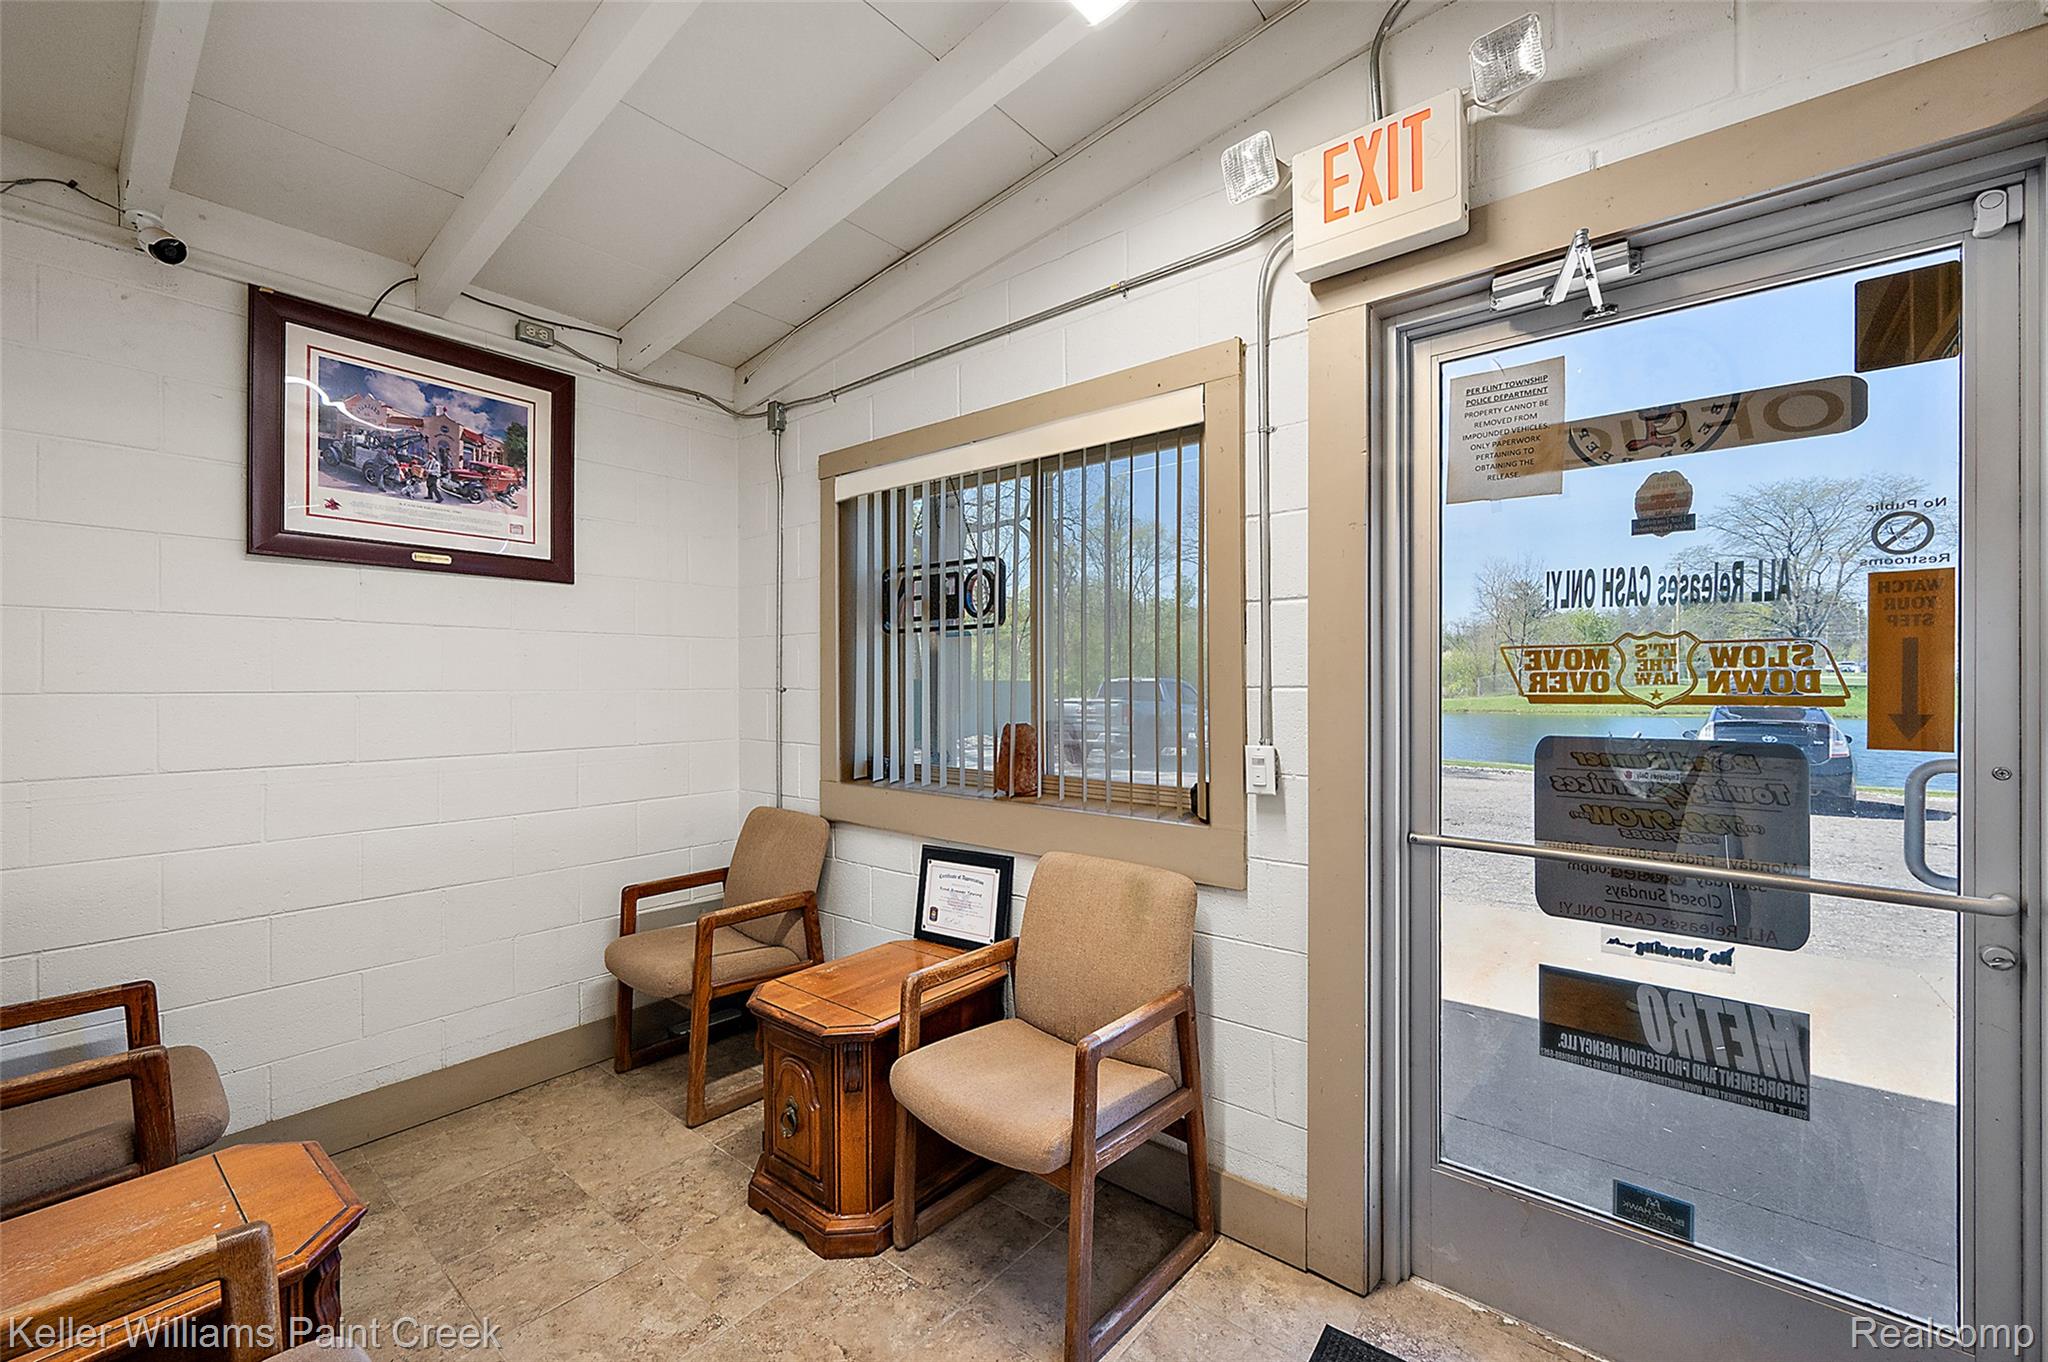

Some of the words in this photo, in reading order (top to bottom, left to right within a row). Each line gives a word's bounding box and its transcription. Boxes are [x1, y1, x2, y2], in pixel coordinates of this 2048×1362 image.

[1323, 107, 1432, 224] EXIT
[1465, 387, 1481, 397] PER
[1482, 383, 1503, 394] FLINT
[1505, 374, 1549, 388] TOWNSHIP
[1465, 395, 1491, 407] POLICE
[1494, 386, 1548, 402] DEPARTMENT
[1464, 407, 1503, 419] PROPERTY
[1503, 401, 1537, 412] CANNOT
[1539, 398, 1549, 407] BE
[1474, 417, 1513, 429] REMOVED
[1514, 412, 1538, 422] FROM
[1462, 428, 1510, 441] IMPOUNDED
[1470, 441, 1491, 451] ONLY
[1492, 434, 1541, 448] PAPERWORK
[1475, 448, 1522, 461] PERTAINING
[1523, 447, 1535, 455] TO
[1474, 460, 1518, 472] OBTAINING
[1519, 458, 1535, 466] THE
[1486, 471, 1521, 481] RELEASE.
